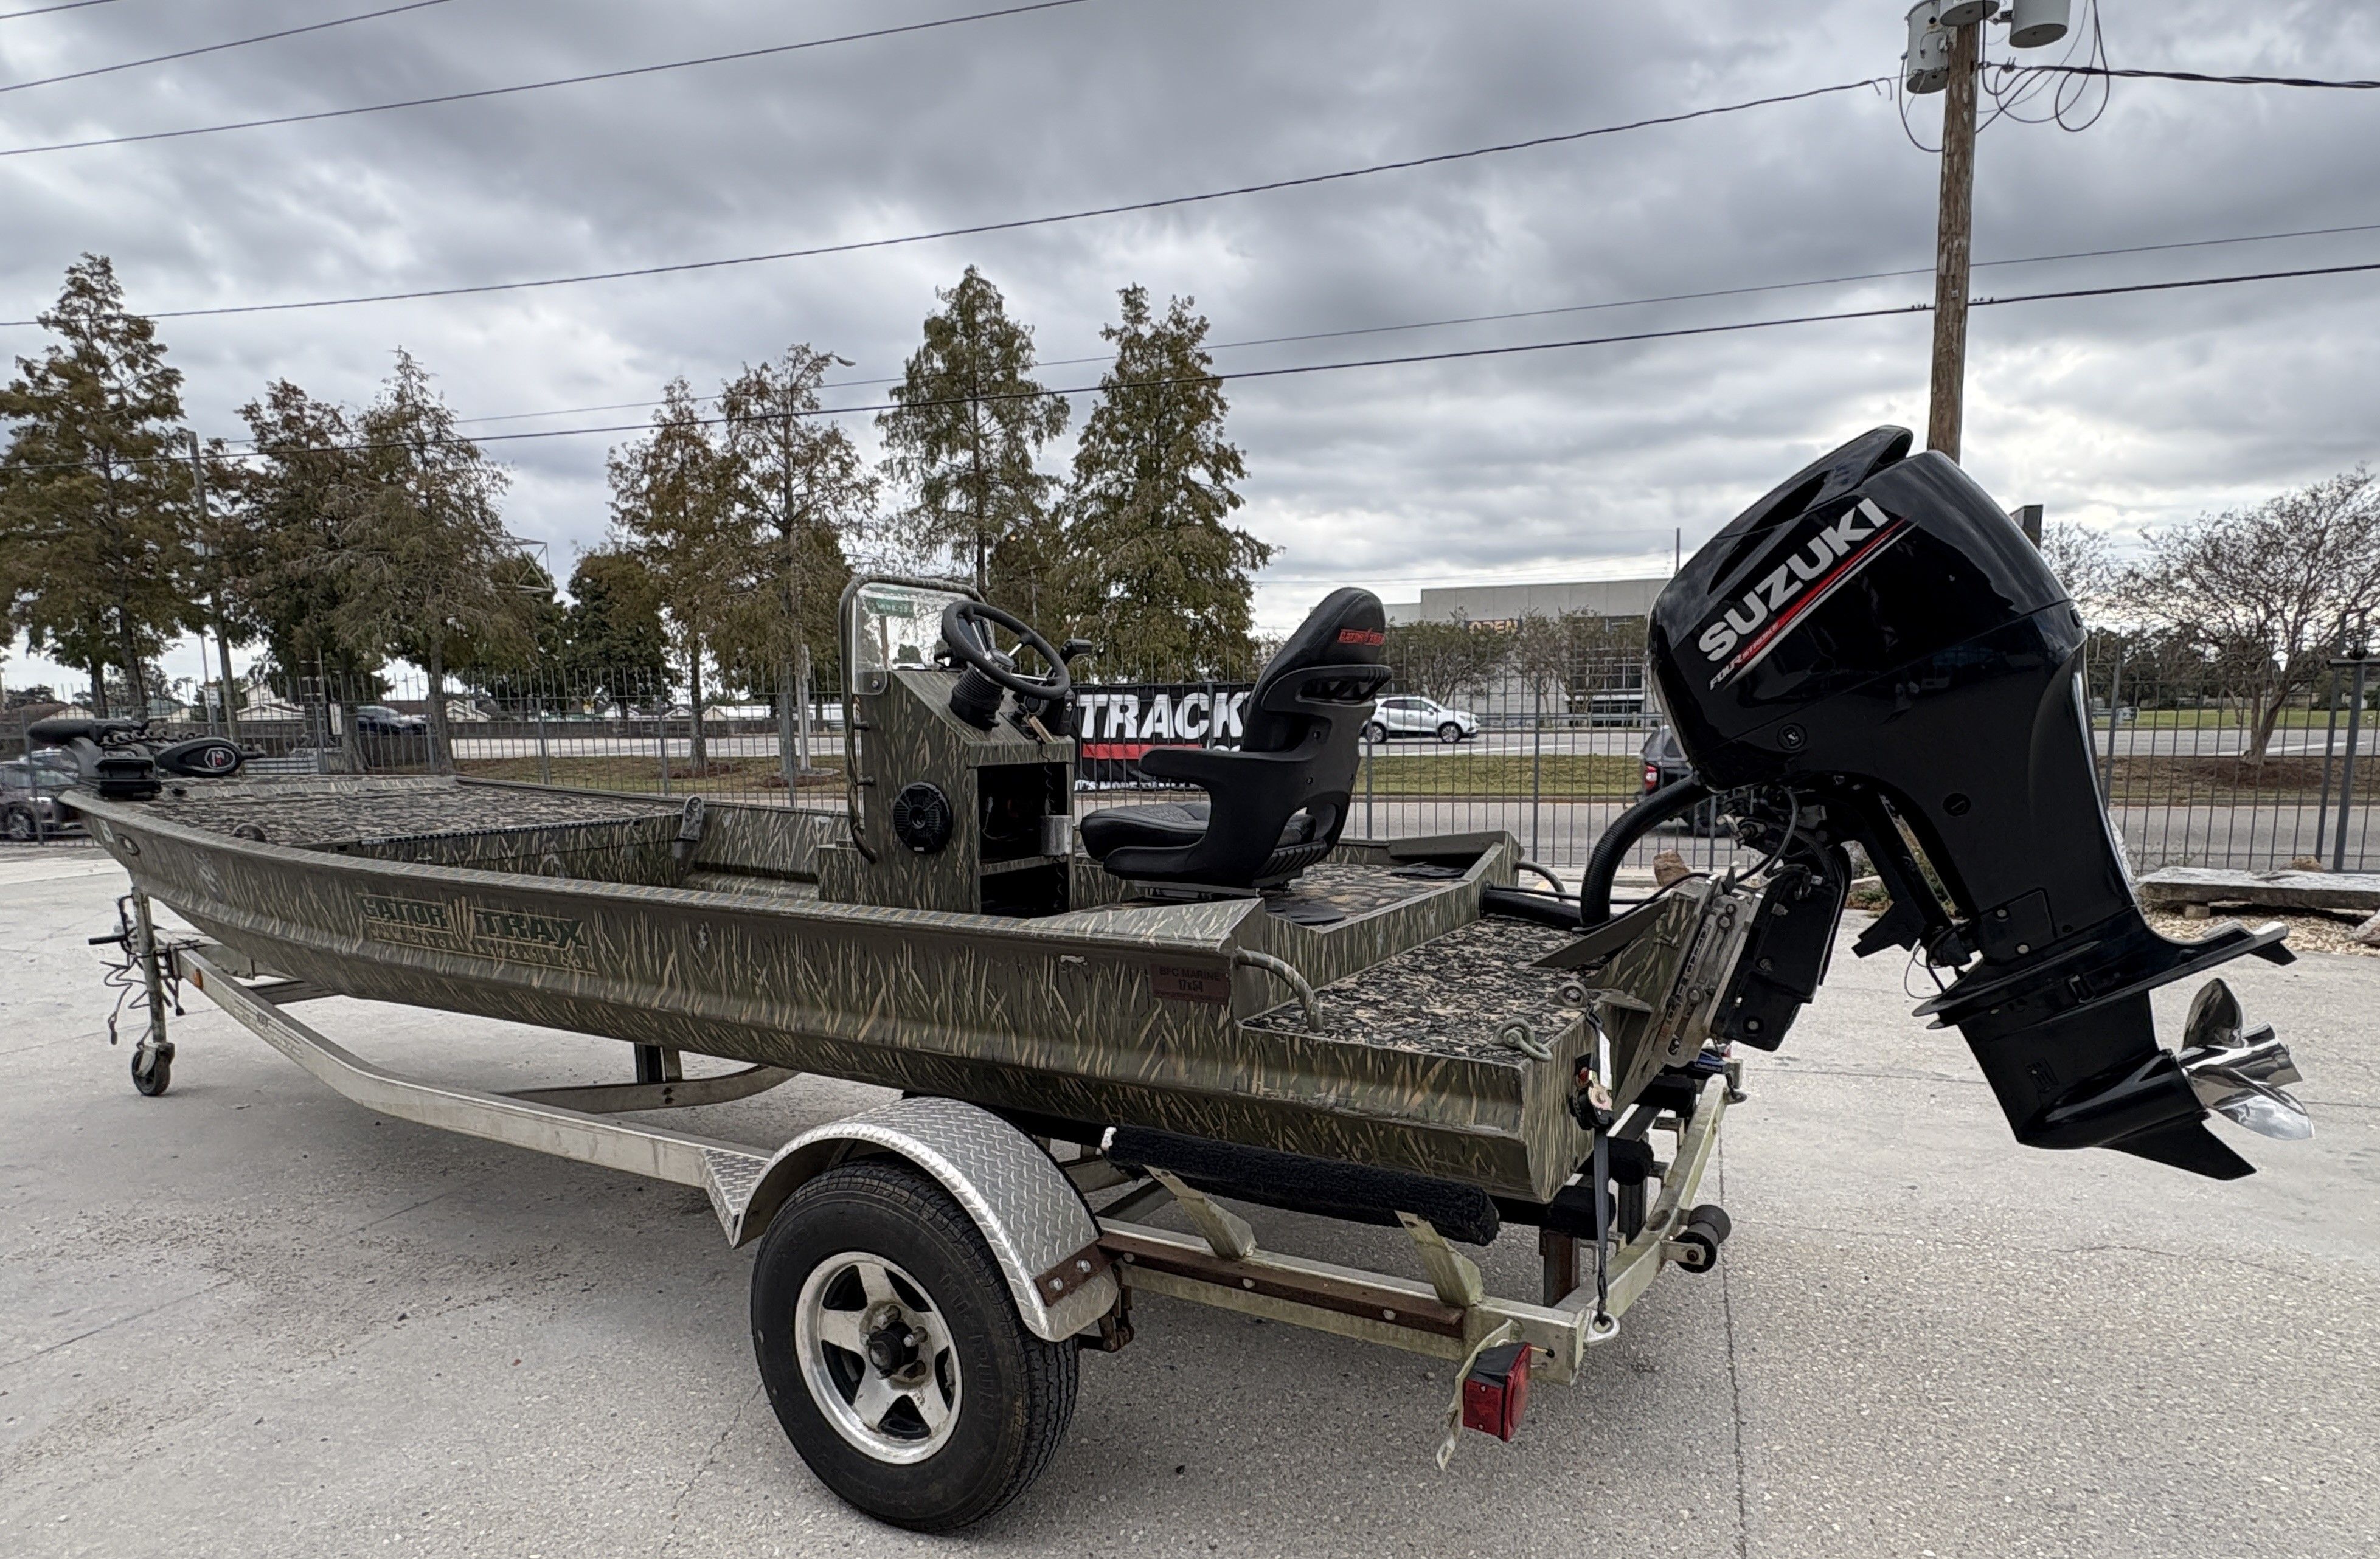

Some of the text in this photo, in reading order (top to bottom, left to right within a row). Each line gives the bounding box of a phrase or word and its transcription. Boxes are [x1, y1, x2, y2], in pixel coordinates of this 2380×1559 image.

[1699, 497, 1889, 662] SUZUKI
[1077, 692, 1251, 739] TRACK
[363, 898, 588, 949] GATOR TRAX
[1181, 969, 1221, 981] MARINE
